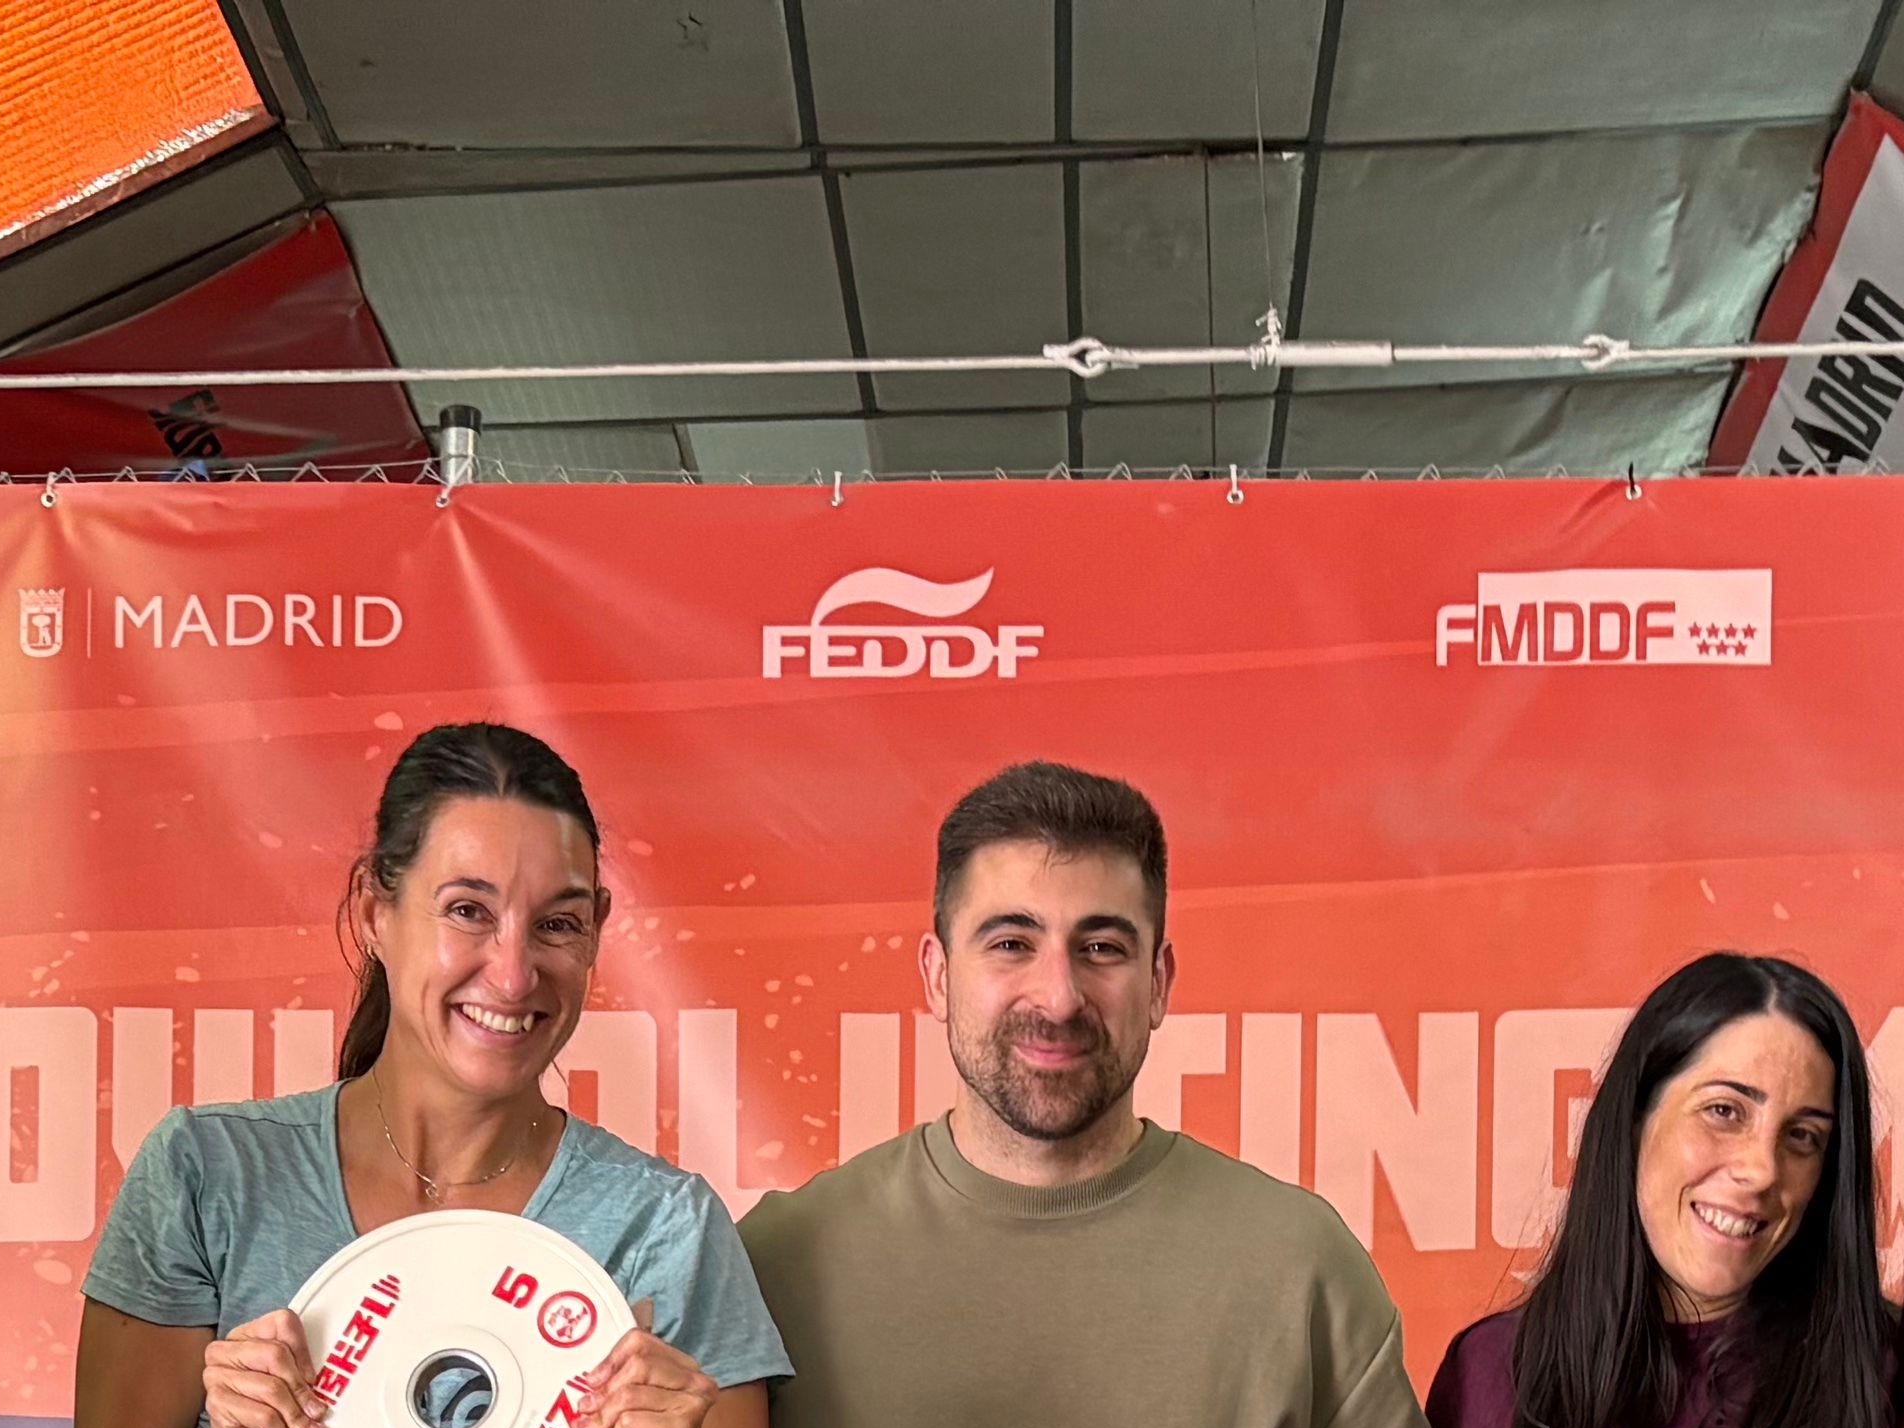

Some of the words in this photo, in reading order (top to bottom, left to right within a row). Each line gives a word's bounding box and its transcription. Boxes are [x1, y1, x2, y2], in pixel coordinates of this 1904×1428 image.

[115, 594, 403, 648] MADRID
[1436, 601, 1676, 666] FMDDF
[762, 625, 1045, 678] FEDDF
[491, 1266, 538, 1309] 5
